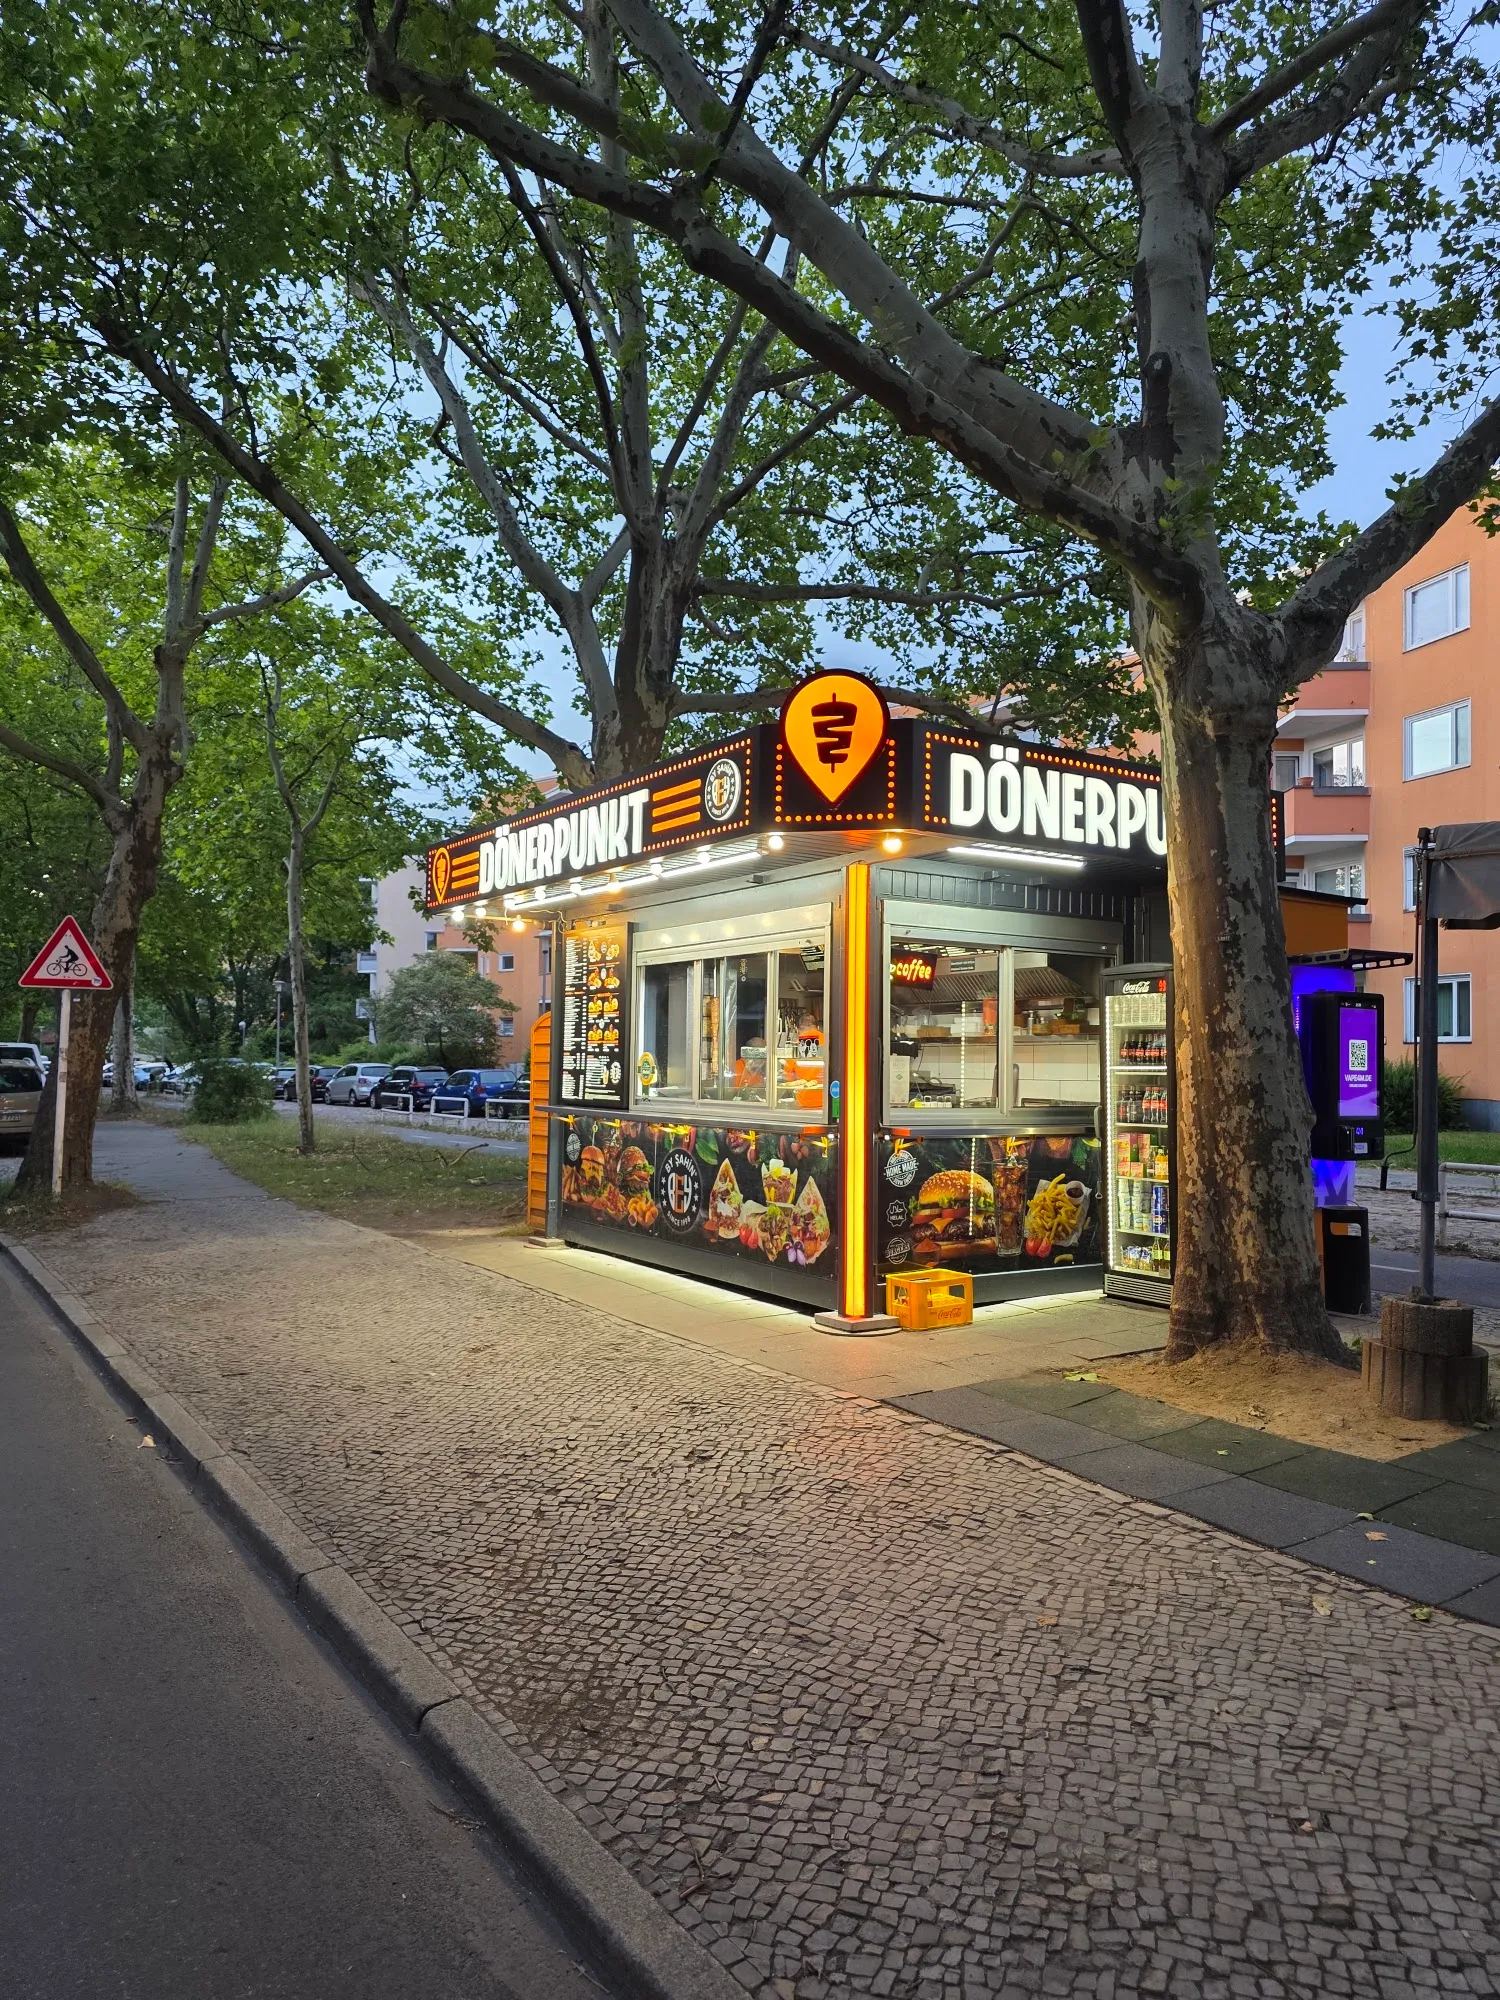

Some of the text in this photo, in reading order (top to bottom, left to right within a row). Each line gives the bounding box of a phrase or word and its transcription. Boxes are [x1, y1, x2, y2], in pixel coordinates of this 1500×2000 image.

[478, 788, 650, 894] DÖNERPUNKT
[896, 958, 932, 982] coffee
[665, 1154, 696, 1177] BY ŞAHİN
[885, 1164, 903, 1178] HOME
[902, 1159, 918, 1173] MADE
[667, 1211, 680, 1226] SINCE
